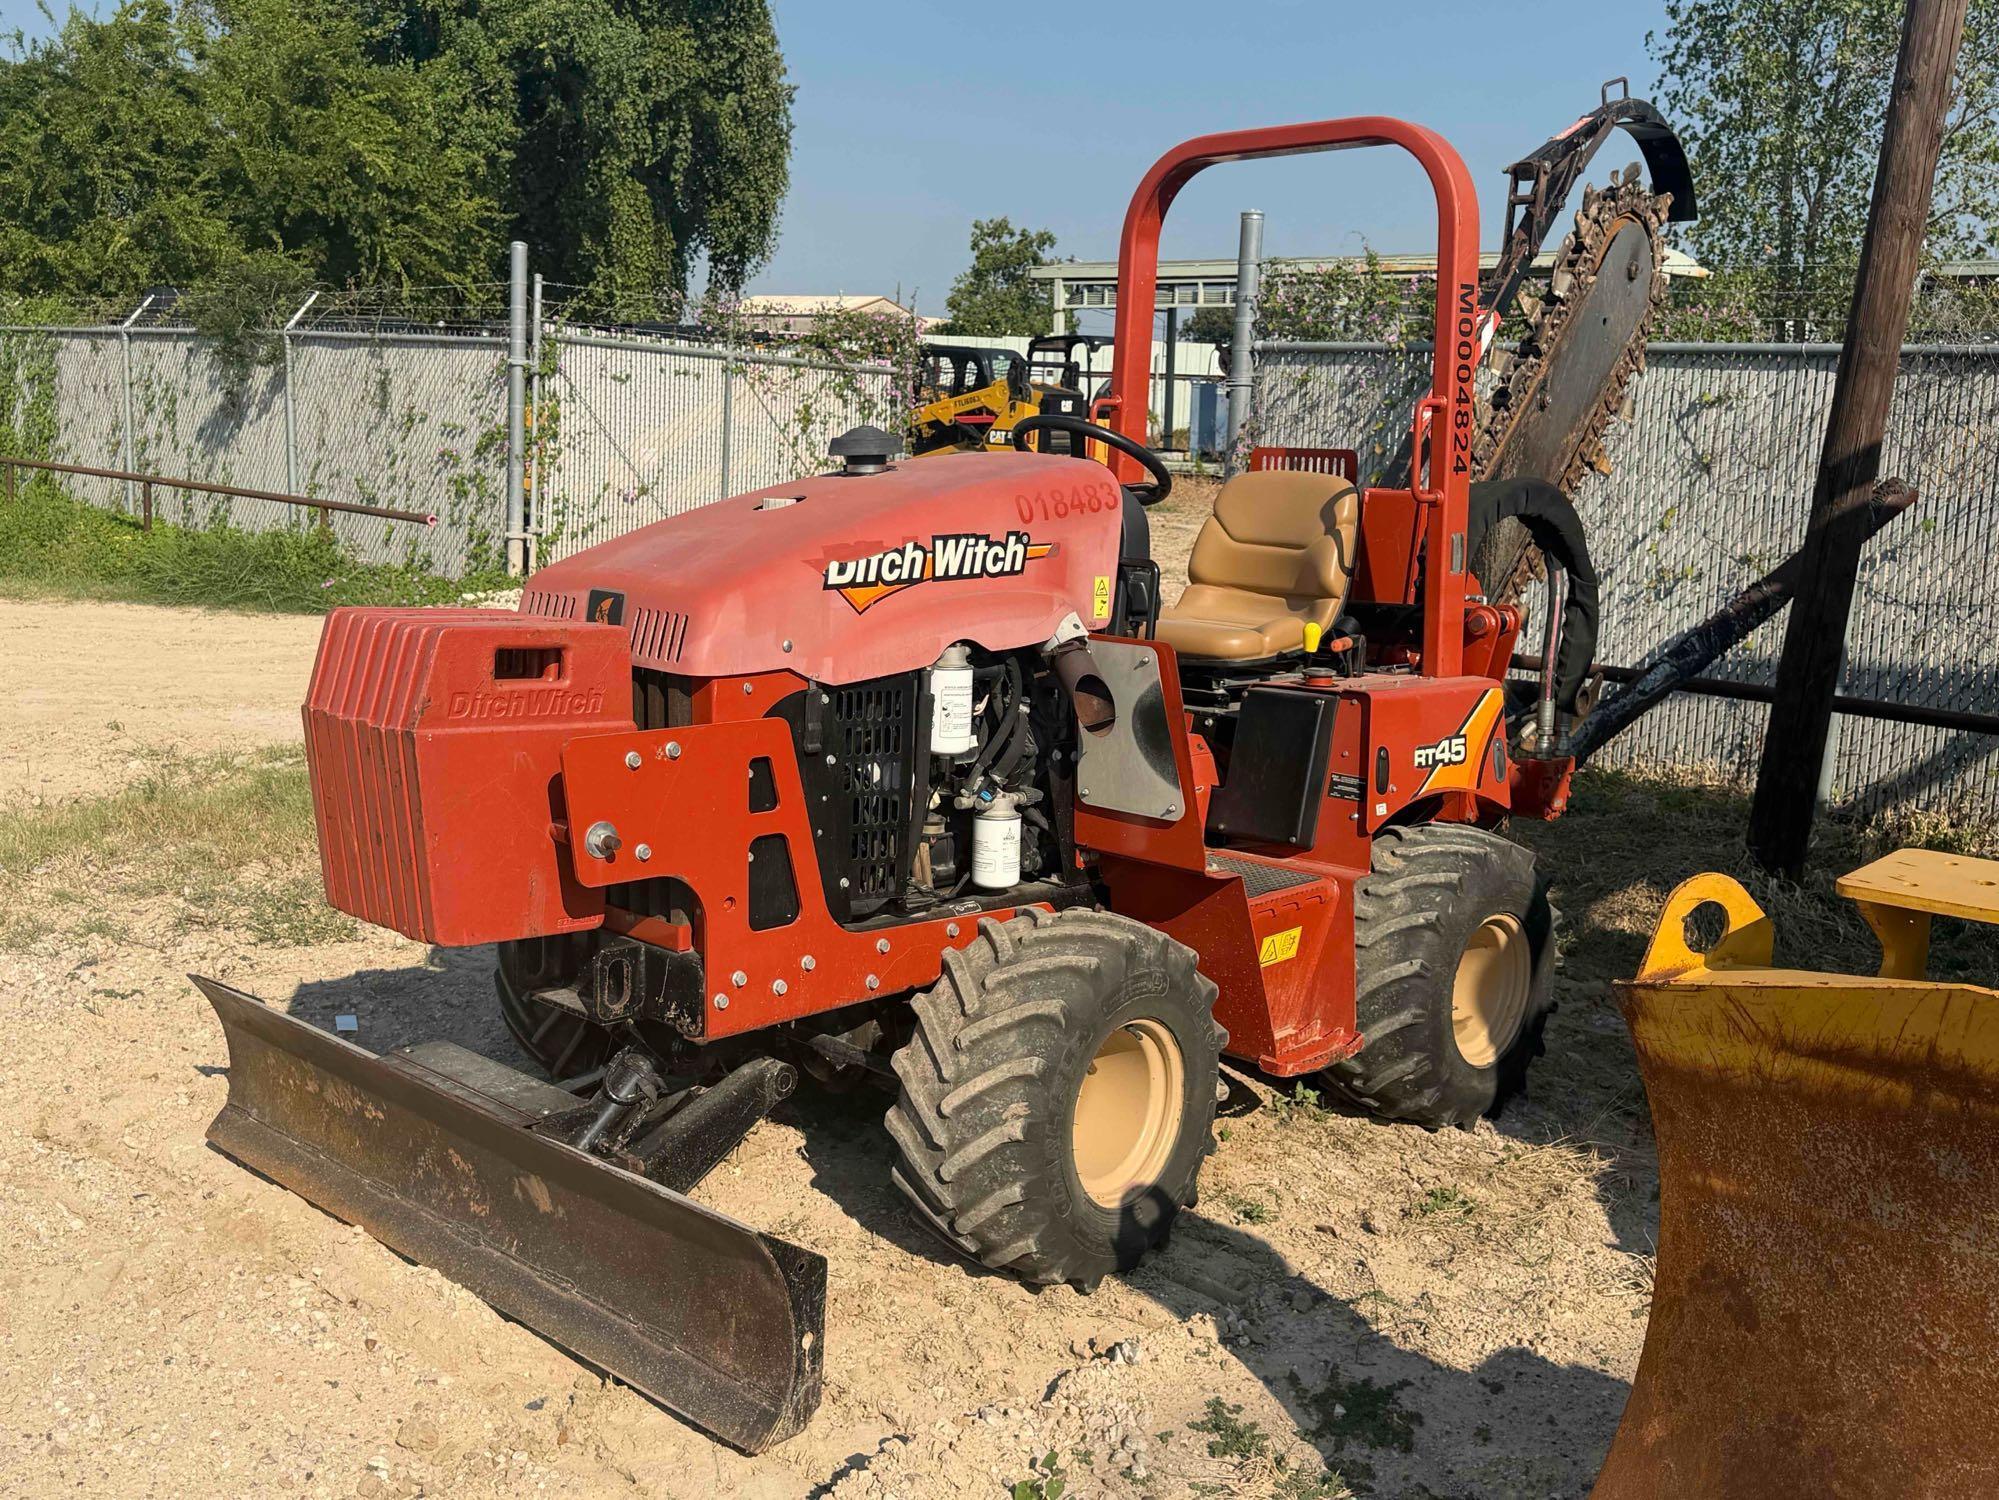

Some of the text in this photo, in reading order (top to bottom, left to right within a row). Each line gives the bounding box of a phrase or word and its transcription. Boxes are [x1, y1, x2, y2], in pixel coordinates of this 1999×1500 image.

[1453, 283, 1475, 475] M0004824
[989, 430, 1006, 444] CAT
[1015, 481, 1119, 525] 018483
[827, 534, 1026, 585] Ditch Witch
[448, 688, 604, 720] Ditch Witch
[1414, 737, 1466, 767] RT45
